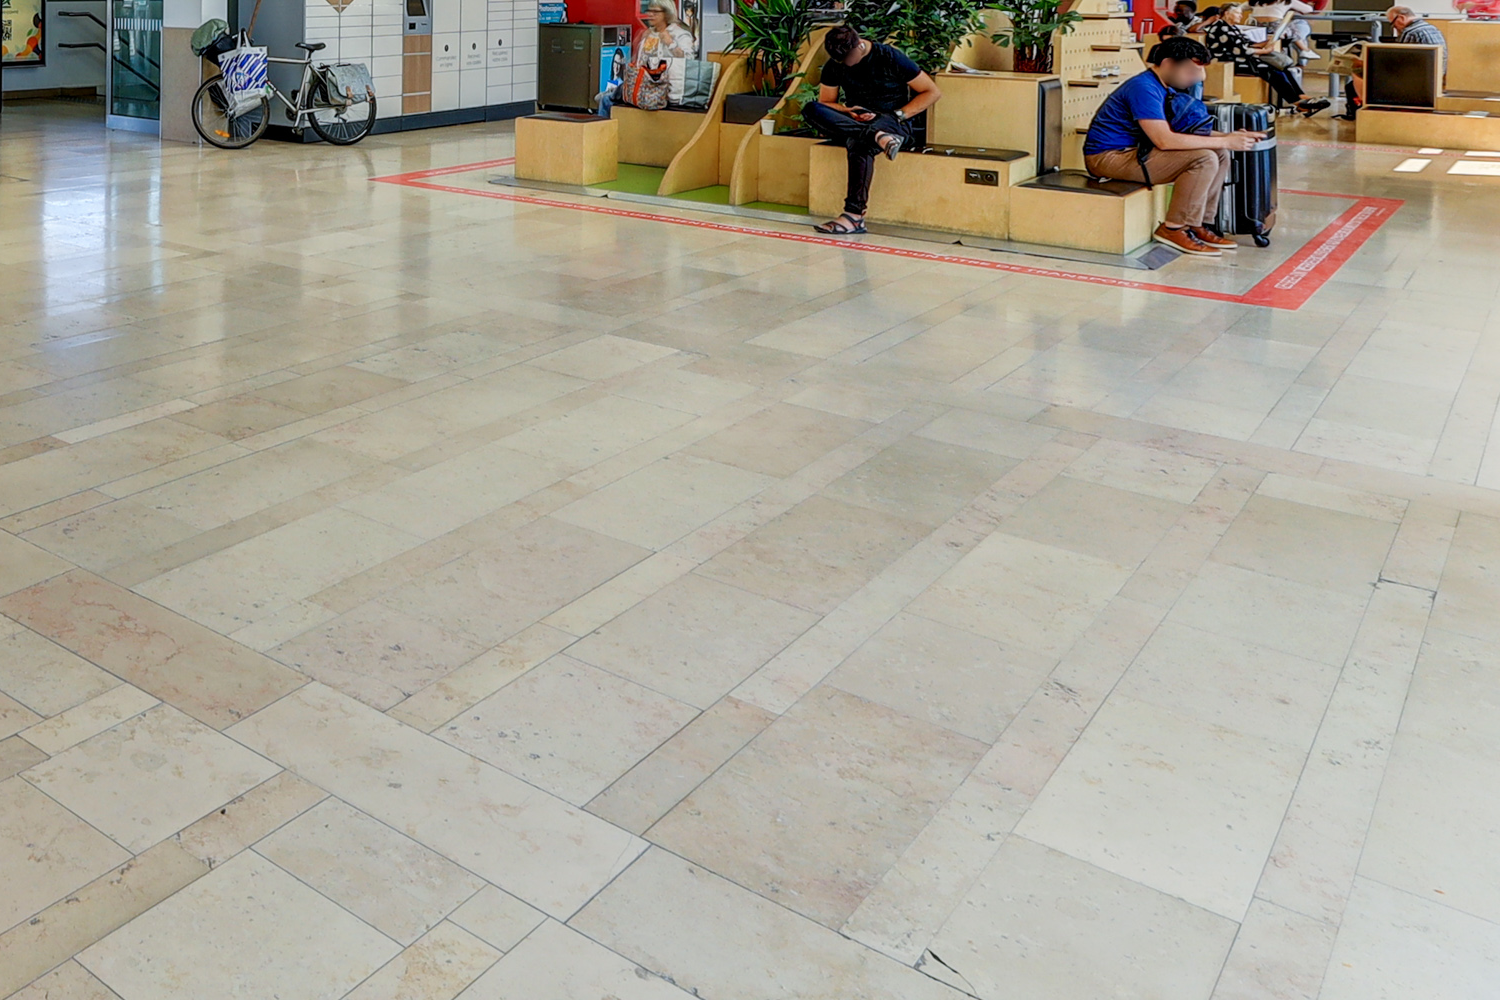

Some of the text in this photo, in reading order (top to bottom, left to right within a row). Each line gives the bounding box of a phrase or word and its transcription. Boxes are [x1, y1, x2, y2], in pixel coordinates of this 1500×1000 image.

[836, 241, 891, 253] MUNIS
[895, 250, 940, 260] D'UN
[944, 256, 991, 267] TITRE
[996, 264, 1022, 272] DE
[1027, 268, 1145, 288] TRANSPORT
